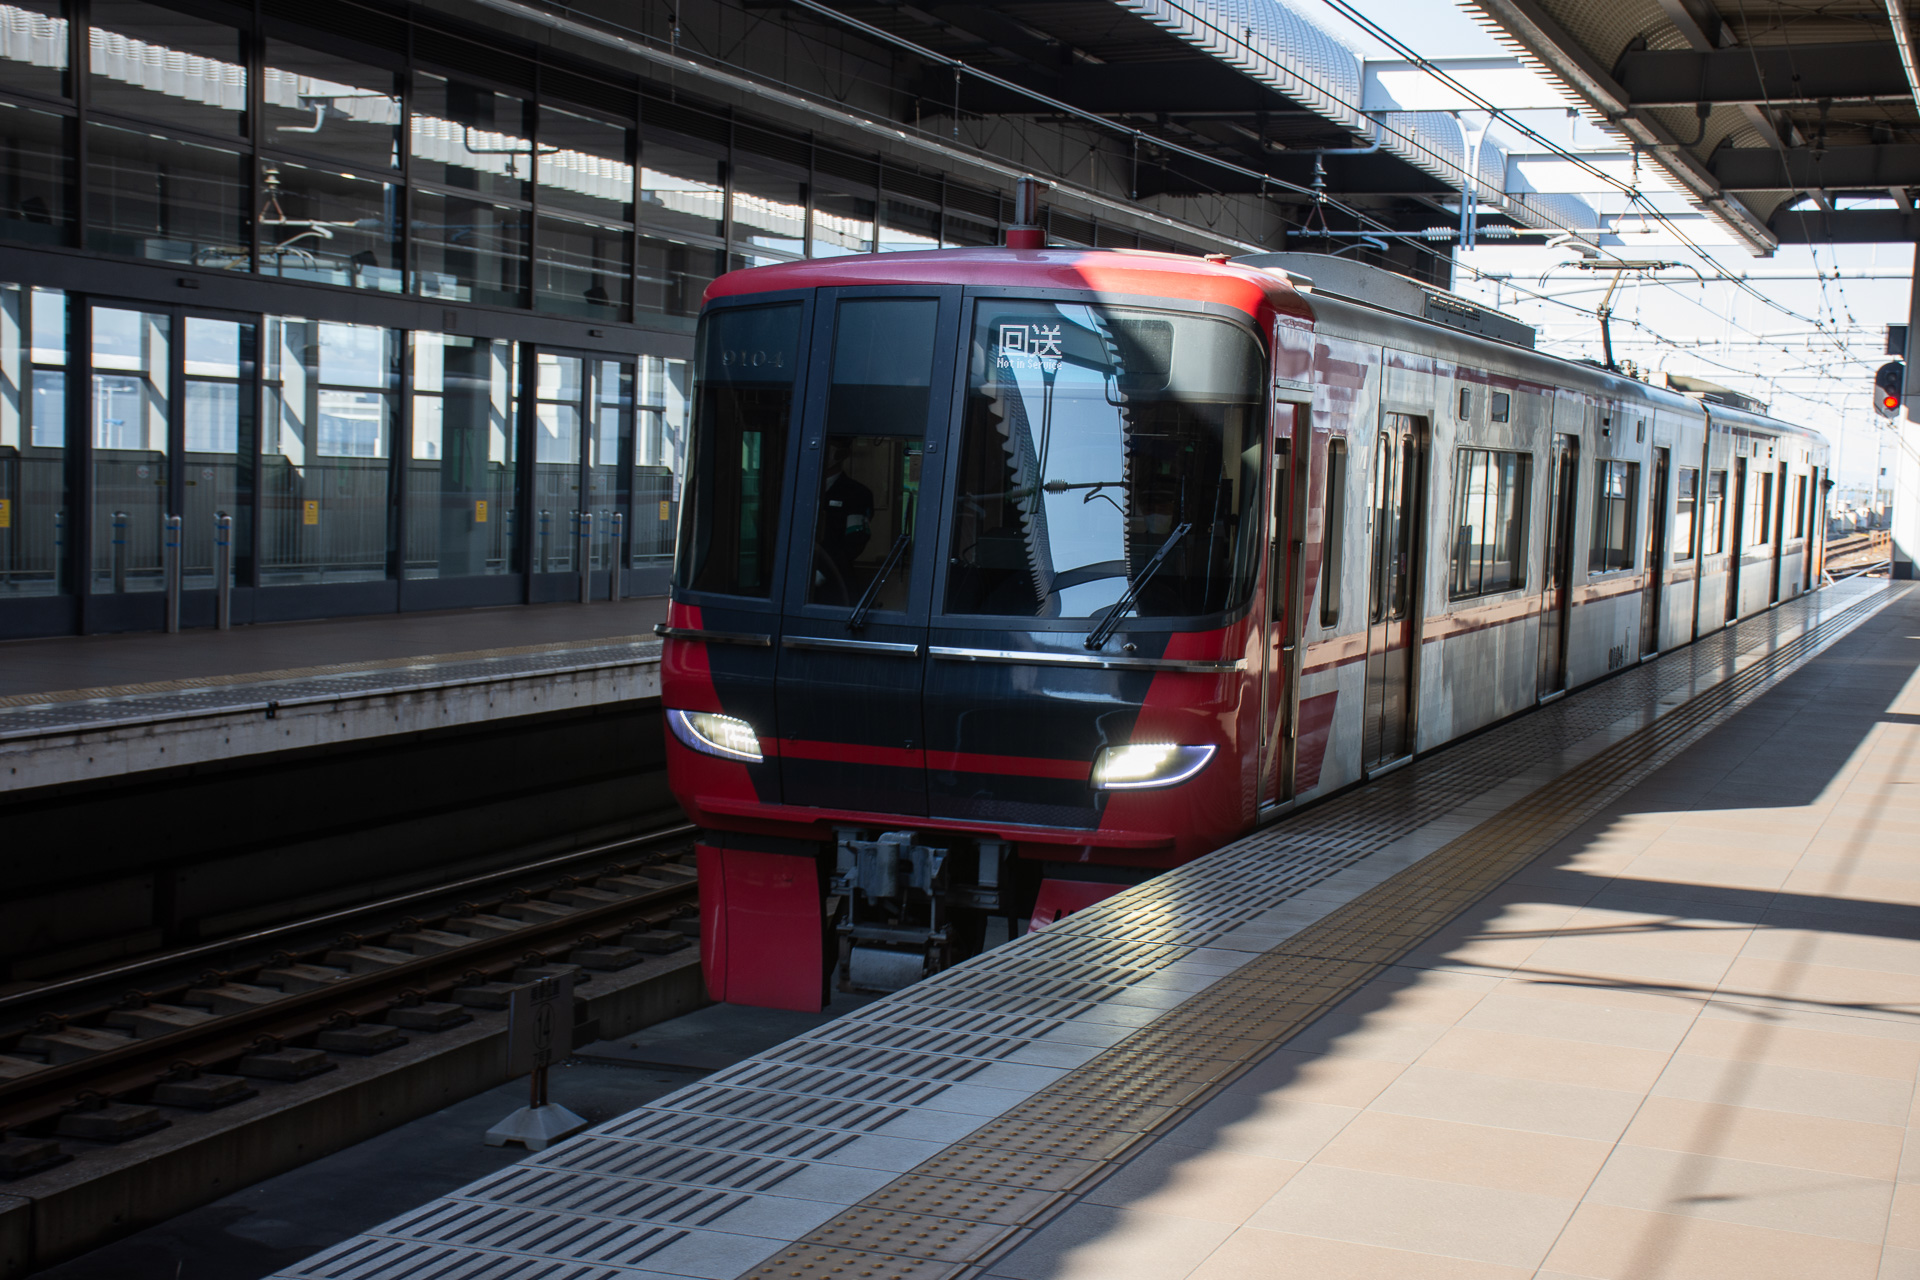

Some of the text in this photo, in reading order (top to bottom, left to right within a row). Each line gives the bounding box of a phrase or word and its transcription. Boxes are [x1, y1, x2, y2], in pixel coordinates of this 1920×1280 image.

[999, 324, 1062, 359] 回送
[722, 350, 784, 367] 9104
[997, 357, 1062, 370] Not in Service
